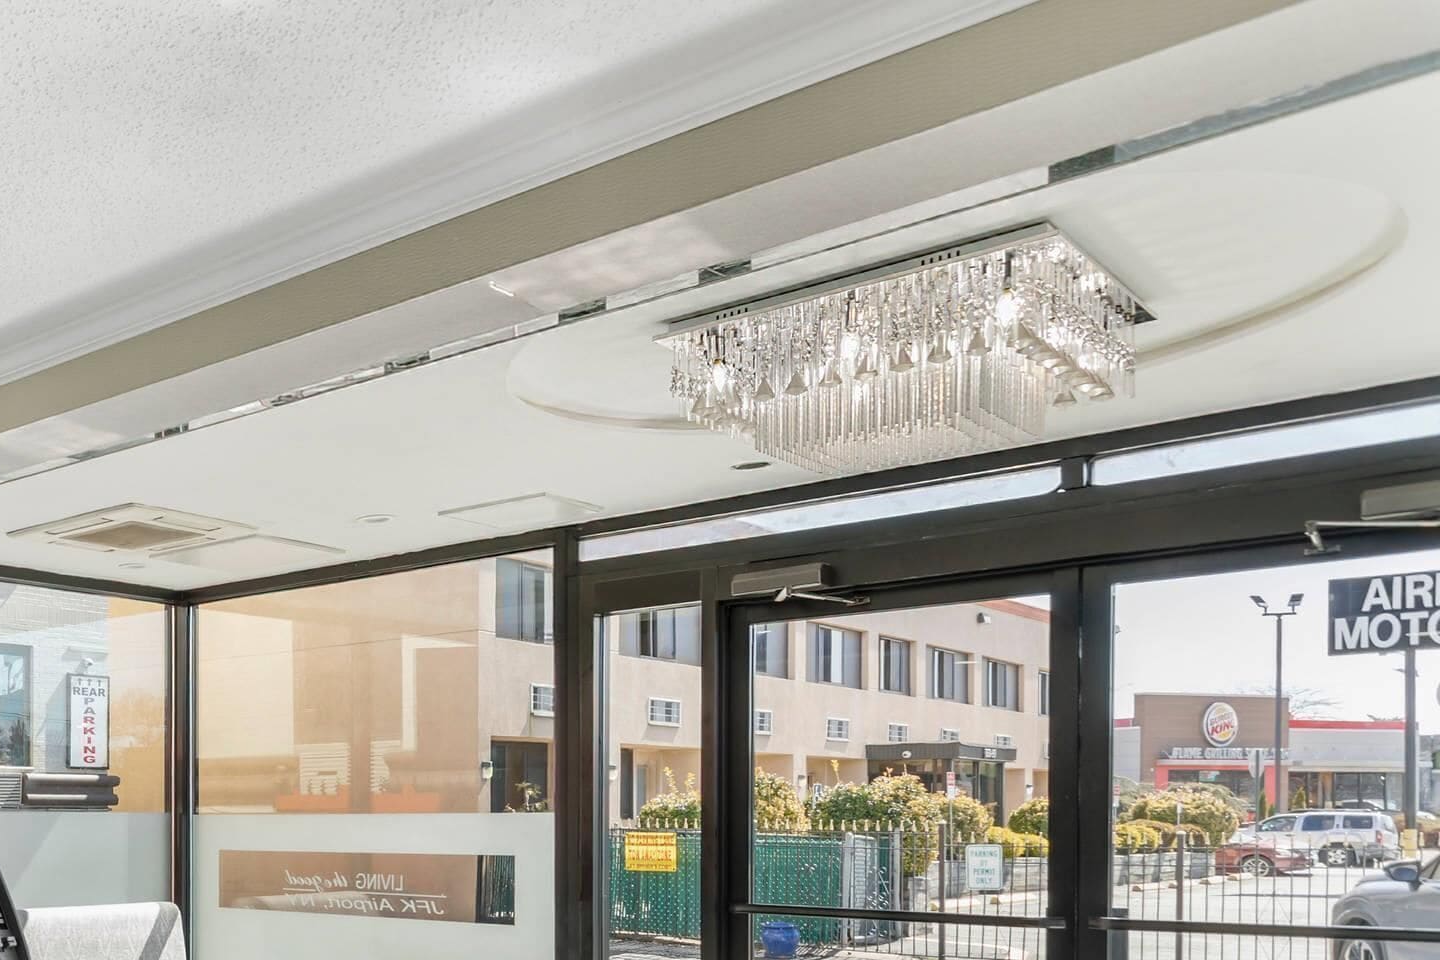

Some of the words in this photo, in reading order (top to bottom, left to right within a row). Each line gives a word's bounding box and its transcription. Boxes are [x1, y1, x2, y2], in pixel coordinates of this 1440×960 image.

[1361, 572, 1440, 611] AIR
[73, 686, 106, 697] REAR
[83, 697, 96, 764] PARKING
